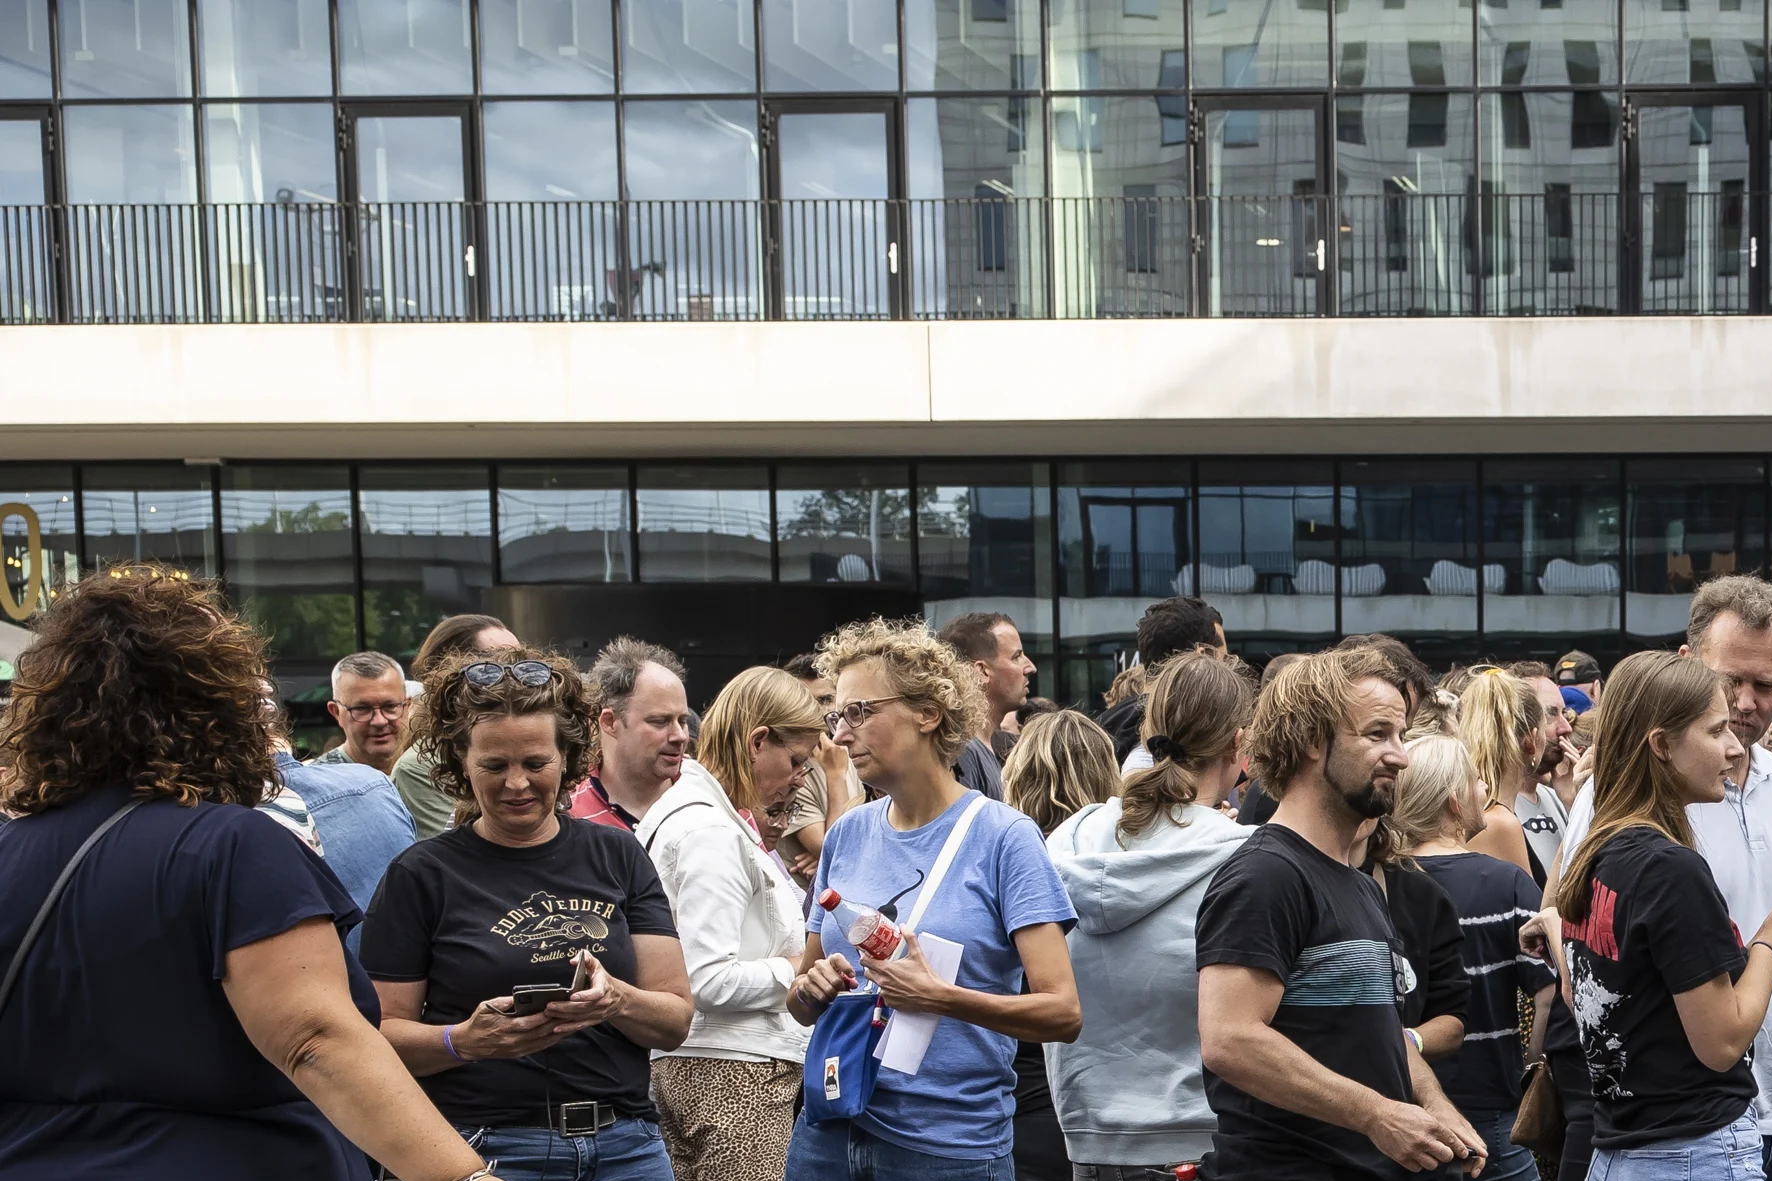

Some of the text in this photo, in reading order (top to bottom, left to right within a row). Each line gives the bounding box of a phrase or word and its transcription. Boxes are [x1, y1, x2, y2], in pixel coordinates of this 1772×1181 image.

[490, 898, 616, 937] EDDIE VEDDER
[530, 950, 566, 963] Seattle
[592, 943, 608, 953] Co.
